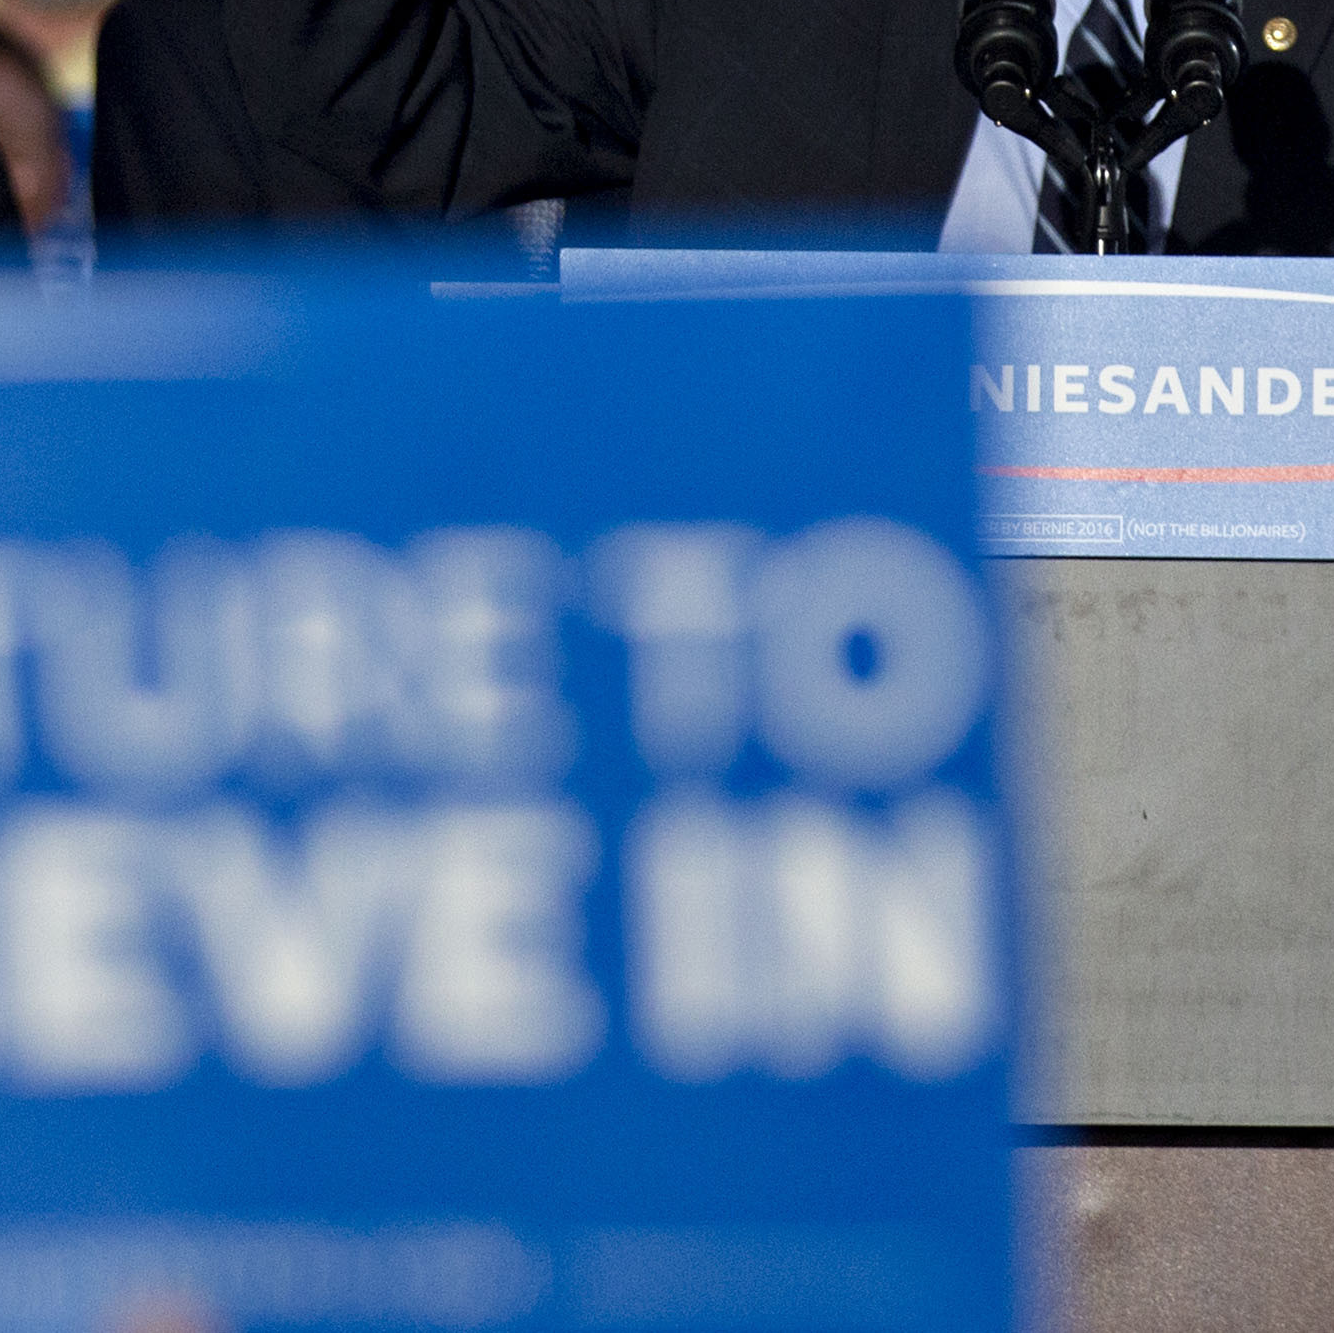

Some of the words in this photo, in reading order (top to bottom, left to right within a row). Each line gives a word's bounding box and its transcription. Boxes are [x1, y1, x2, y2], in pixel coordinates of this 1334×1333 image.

[589, 516, 995, 788] TO
[1023, 521, 1075, 537] BERNIE
[1078, 521, 1114, 538] 2016
[1127, 519, 1168, 541] (NOT
[1169, 522, 1199, 539] THE
[1200, 522, 1307, 542] BILLIONAIRES)
[625, 778, 999, 1086] IN
